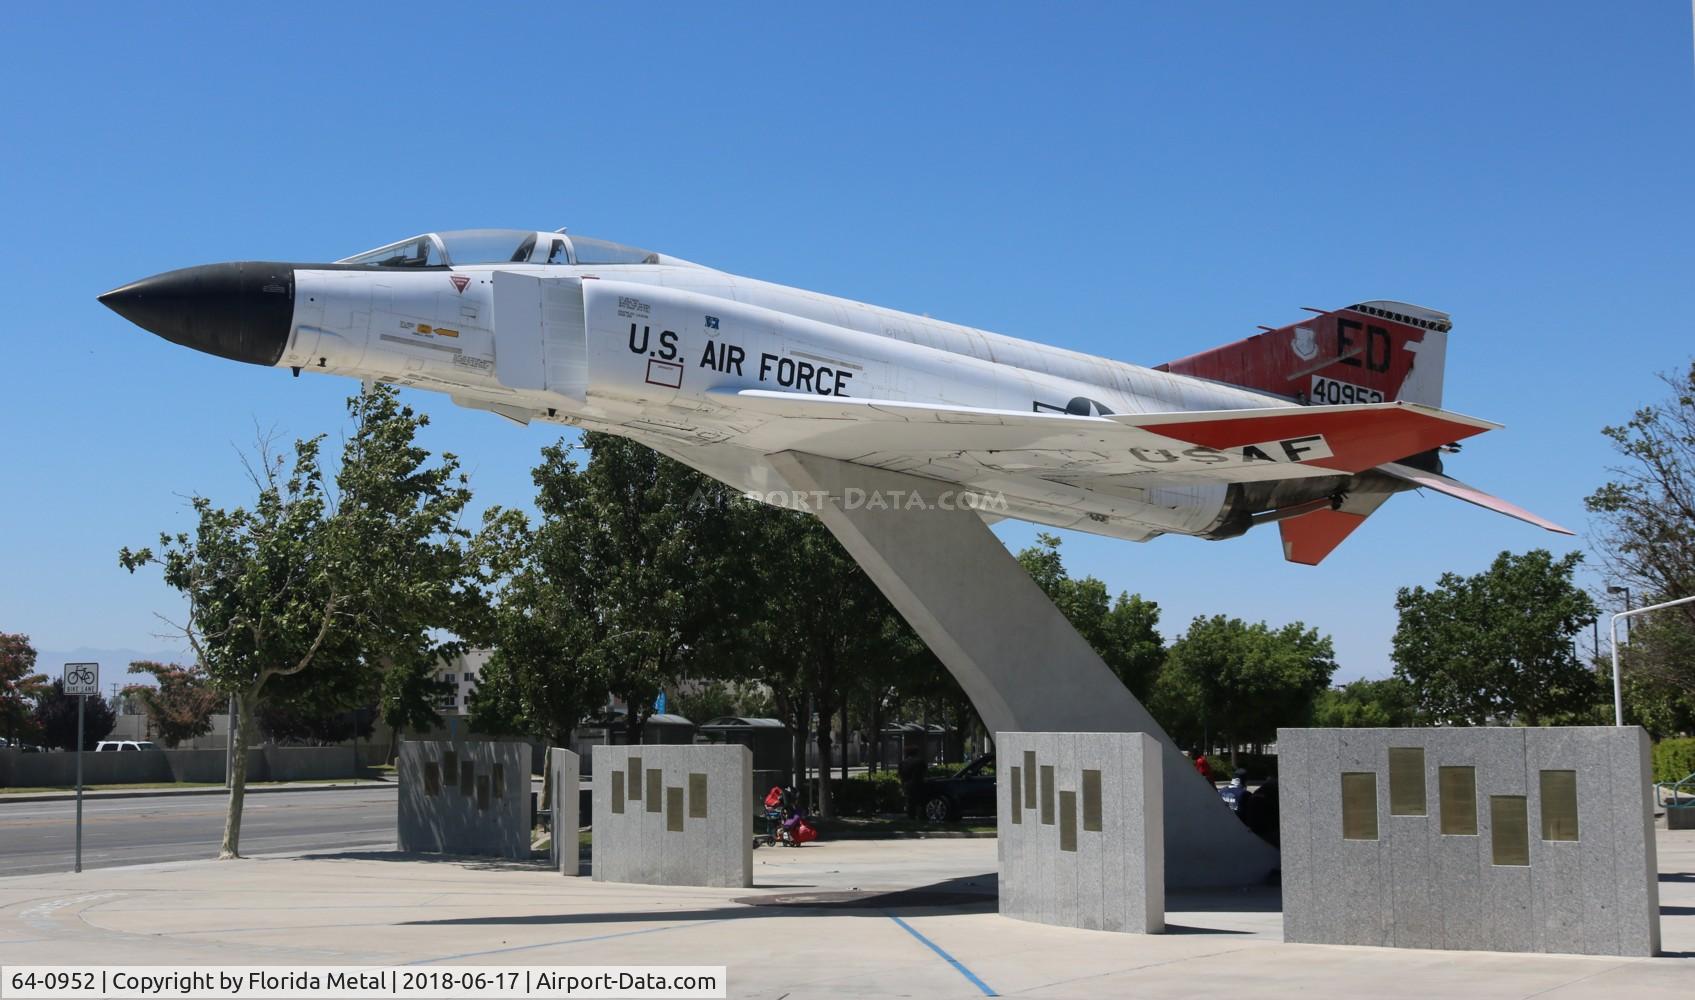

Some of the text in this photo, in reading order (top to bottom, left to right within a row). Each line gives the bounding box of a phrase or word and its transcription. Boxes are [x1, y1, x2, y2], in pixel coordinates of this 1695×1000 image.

[629, 323, 853, 398] U.S. AIR FORCE
[1337, 317, 1391, 374] ED
[1130, 435, 1322, 464] USAF
